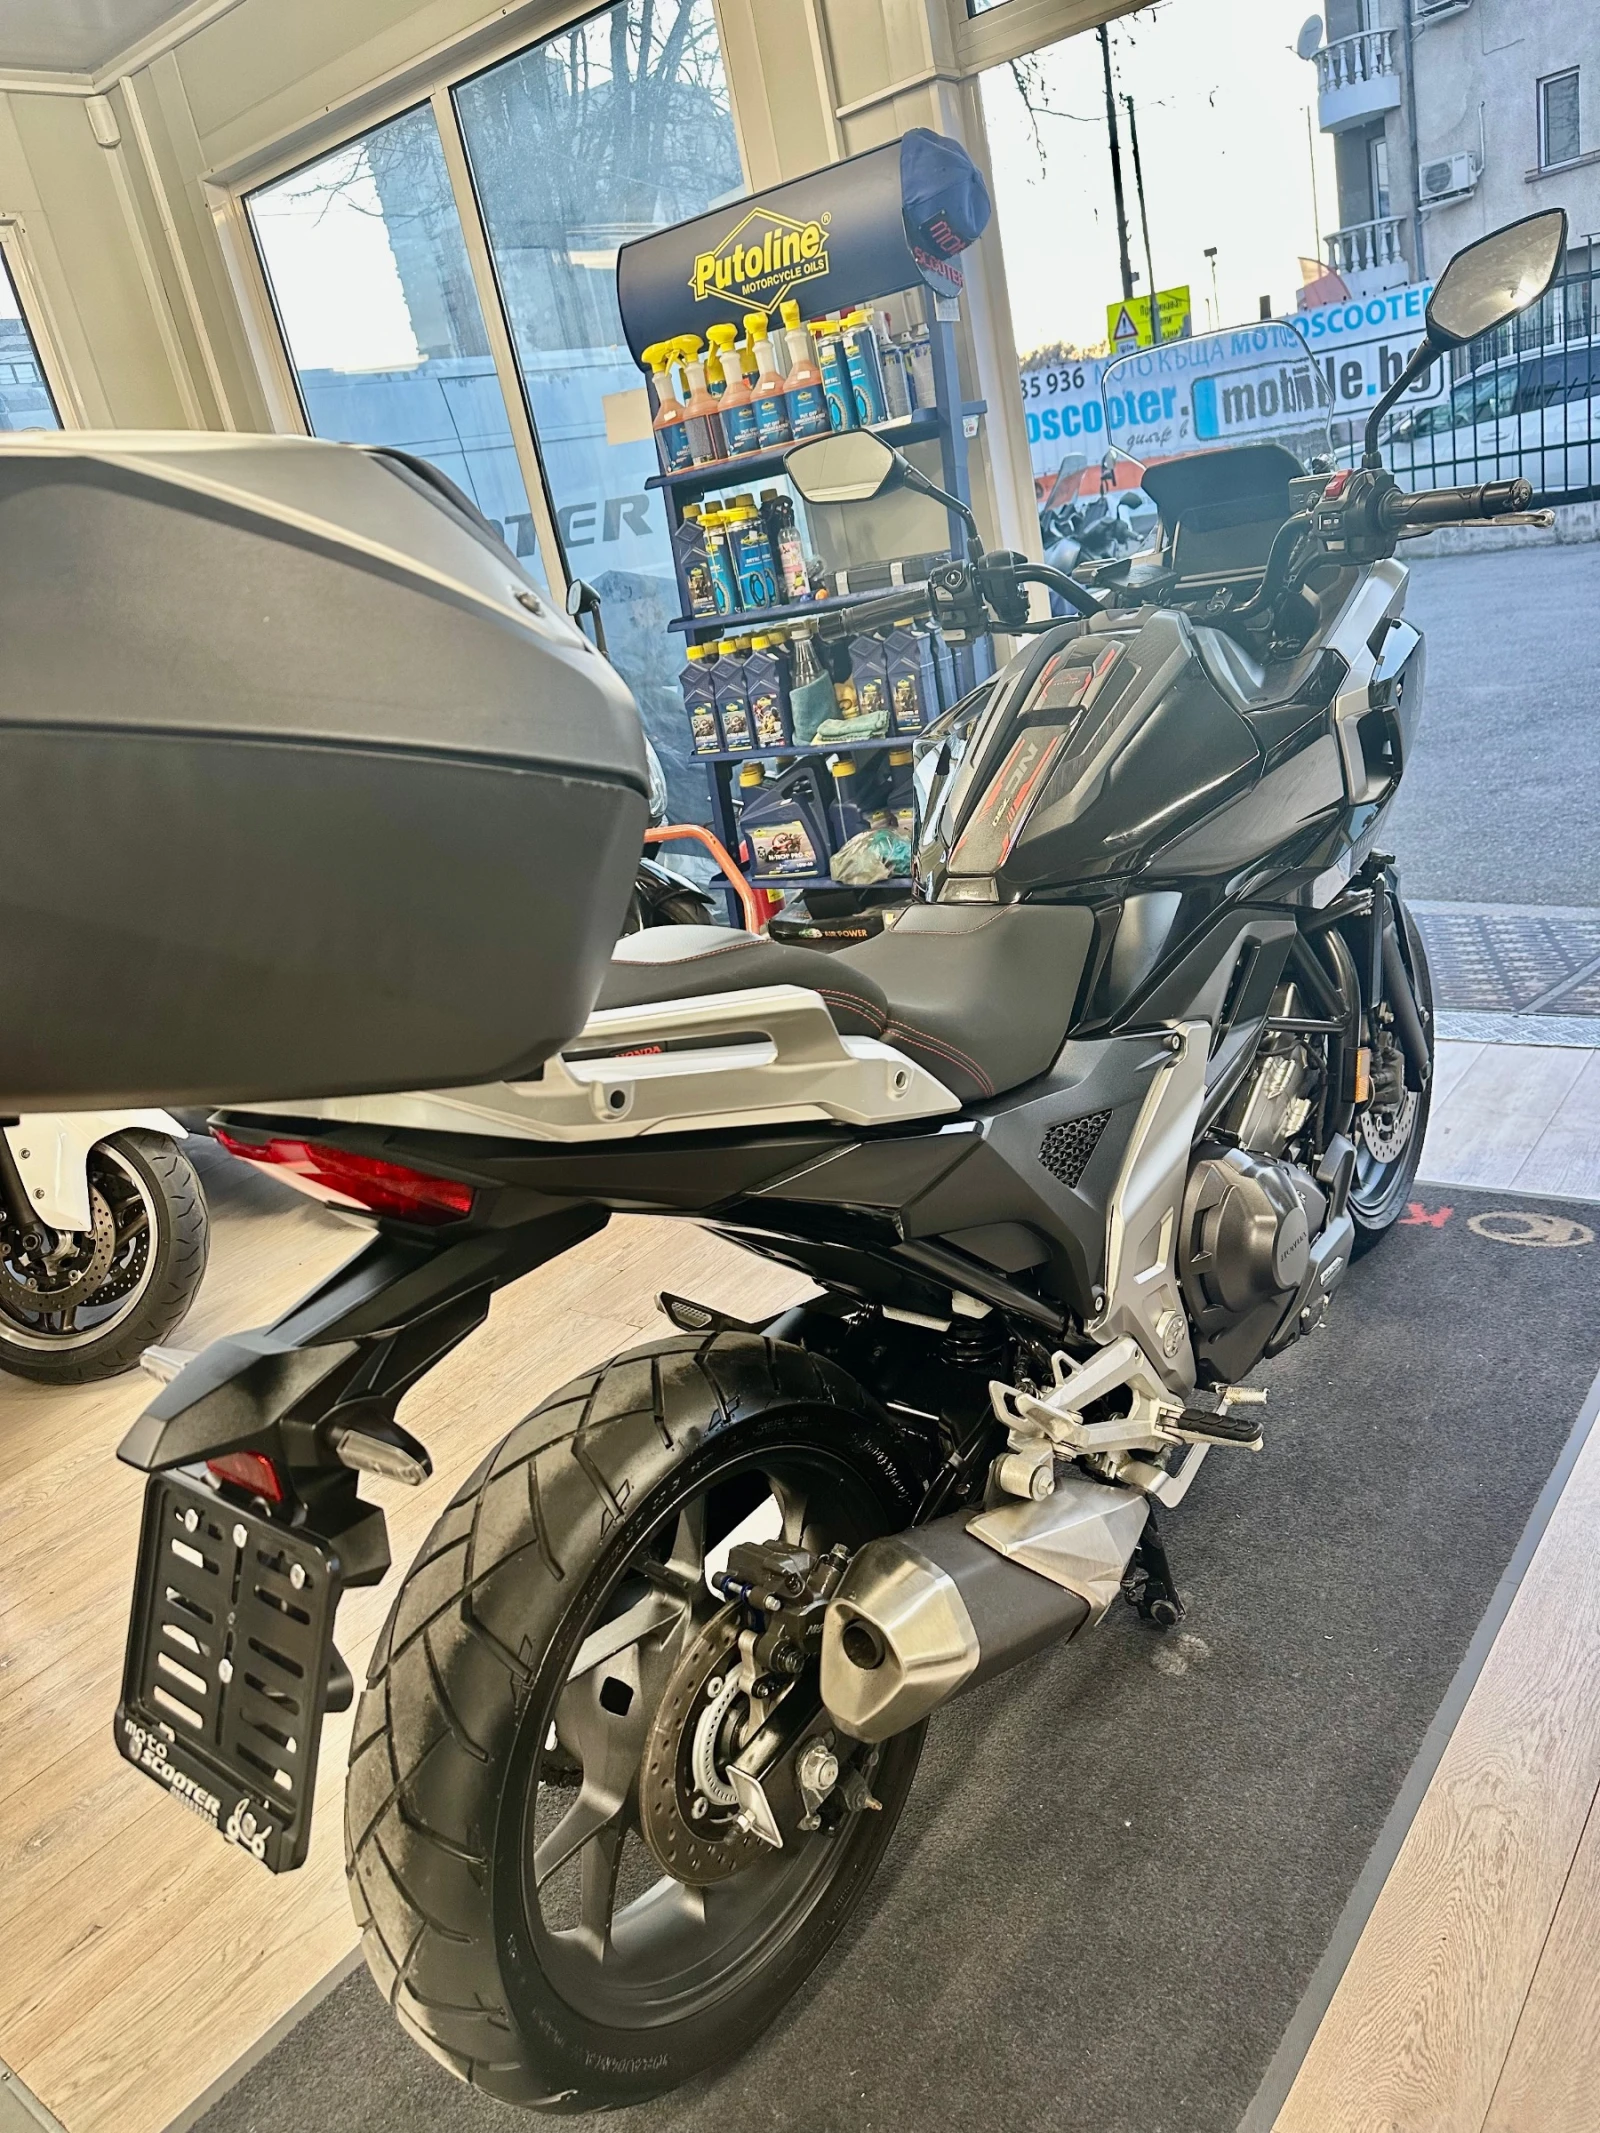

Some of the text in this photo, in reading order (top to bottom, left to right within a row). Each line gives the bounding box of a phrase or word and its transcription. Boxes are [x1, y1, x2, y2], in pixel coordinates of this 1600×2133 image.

[695, 221, 821, 297] Putoline
[741, 258, 825, 296] MOTORCYCLE OILS
[1046, 366, 1085, 396] 936
[488, 493, 653, 558] TER
[839, 929, 868, 938] POWER
[140, 1749, 222, 1817] SCOOTER
